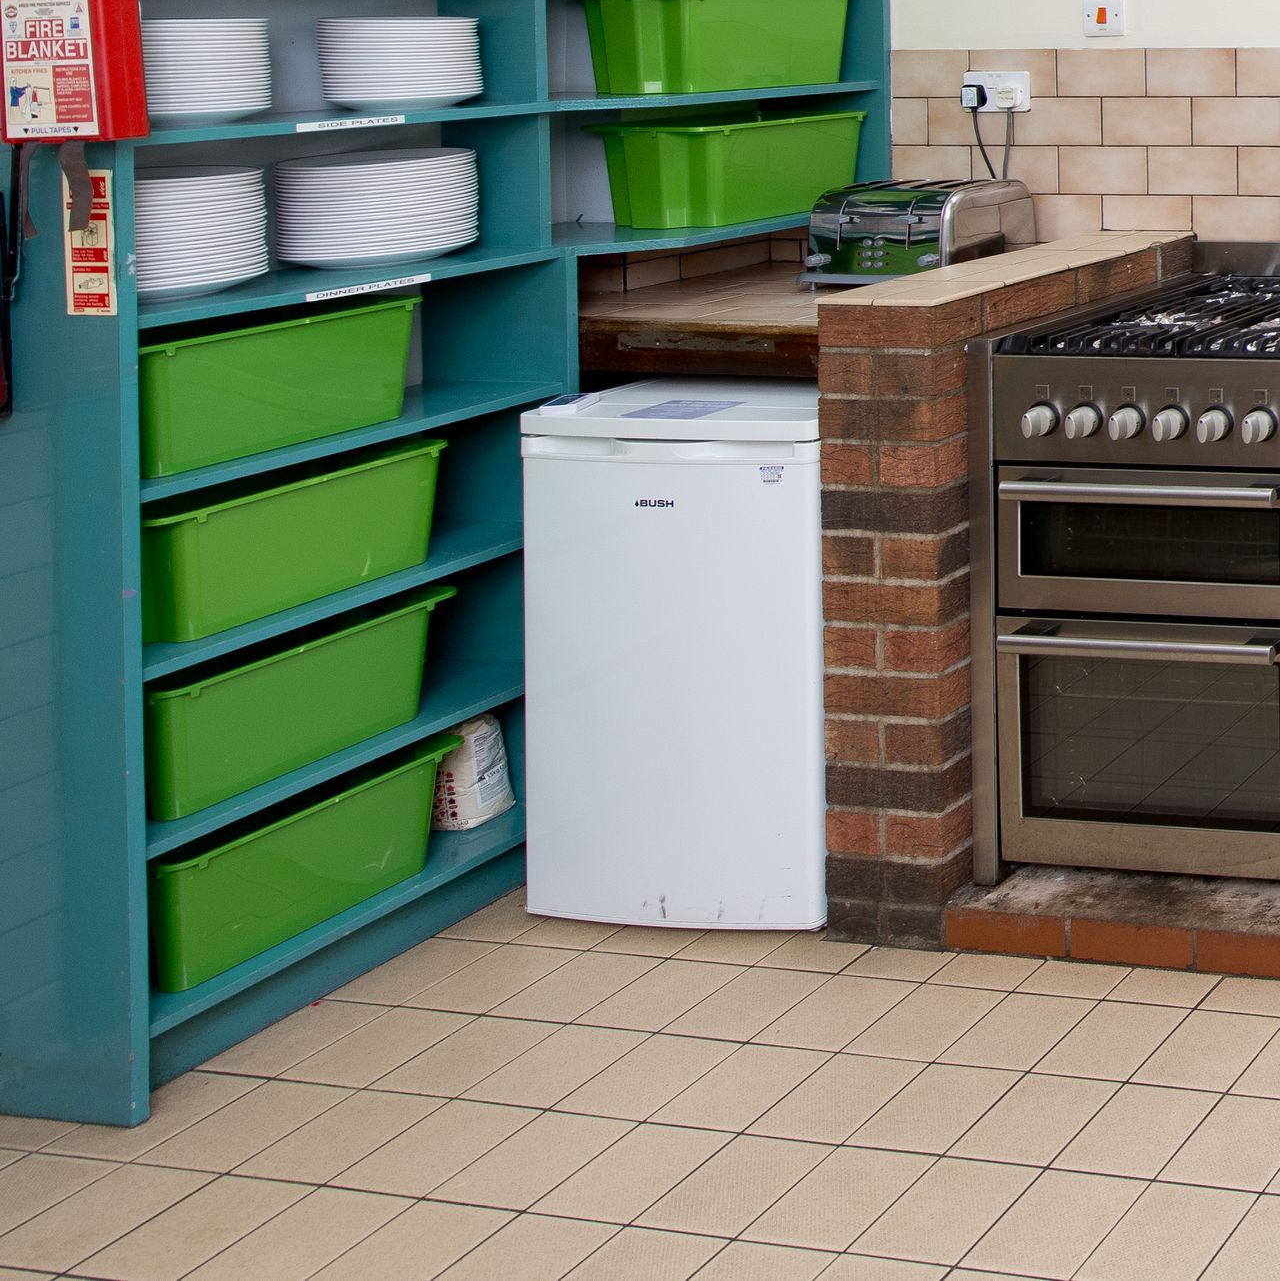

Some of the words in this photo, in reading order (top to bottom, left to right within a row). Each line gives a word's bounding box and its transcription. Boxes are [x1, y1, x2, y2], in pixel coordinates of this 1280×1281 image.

[26, 20, 64, 38] FIRE
[6, 39, 87, 59] BLANKET
[351, 116, 398, 126] PLATES
[316, 286, 365, 299] DINNER
[368, 277, 415, 290] PLATES
[639, 499, 674, 508] BUSH
